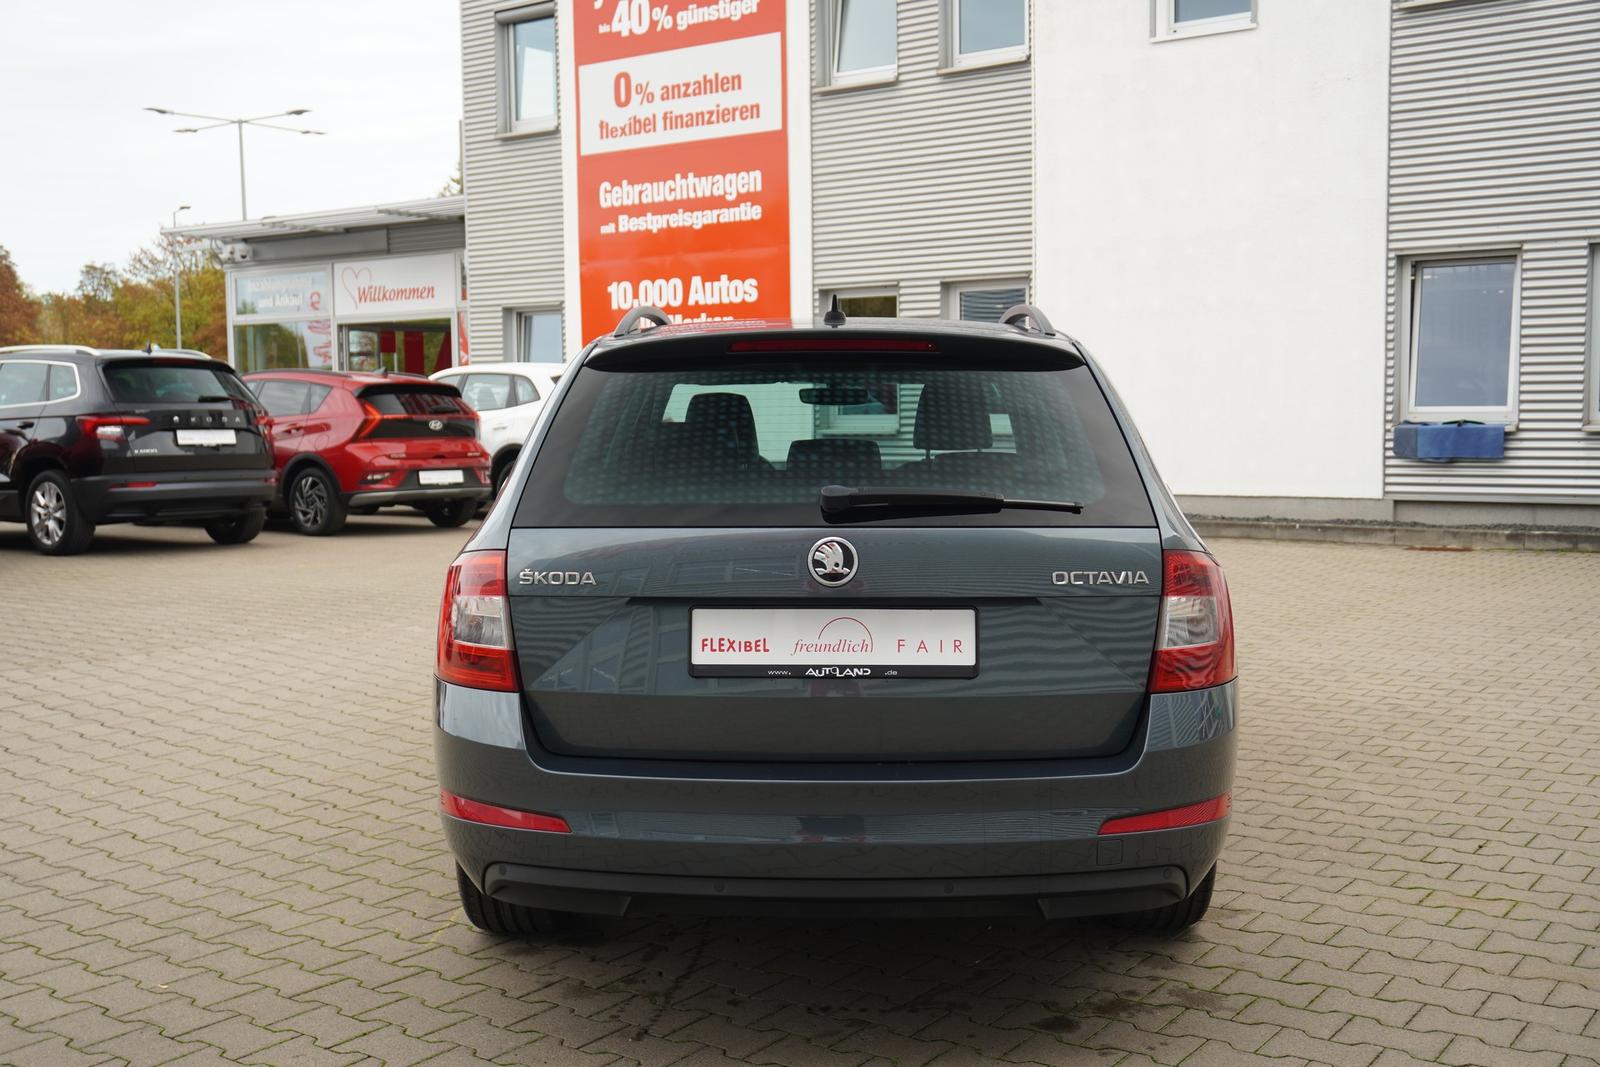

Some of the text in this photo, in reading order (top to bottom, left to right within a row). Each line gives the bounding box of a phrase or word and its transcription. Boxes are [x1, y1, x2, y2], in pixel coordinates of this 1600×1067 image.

[676, 0, 759, 31] günstiger
[660, 73, 742, 101] anzahlen
[599, 103, 761, 140] flexibel finanzieren
[599, 169, 762, 208] Gebrauchtwagen
[618, 202, 762, 233] Bestpreisgarantie
[357, 284, 435, 304] Willkommen
[607, 274, 758, 310] 10.000 Autos
[519, 568, 597, 585] ŠKODA
[1052, 570, 1150, 585] OCTAVIA
[791, 638, 869, 656] freundlich
[897, 639, 963, 653] FAIR
[805, 666, 872, 678] AUTOLAND
